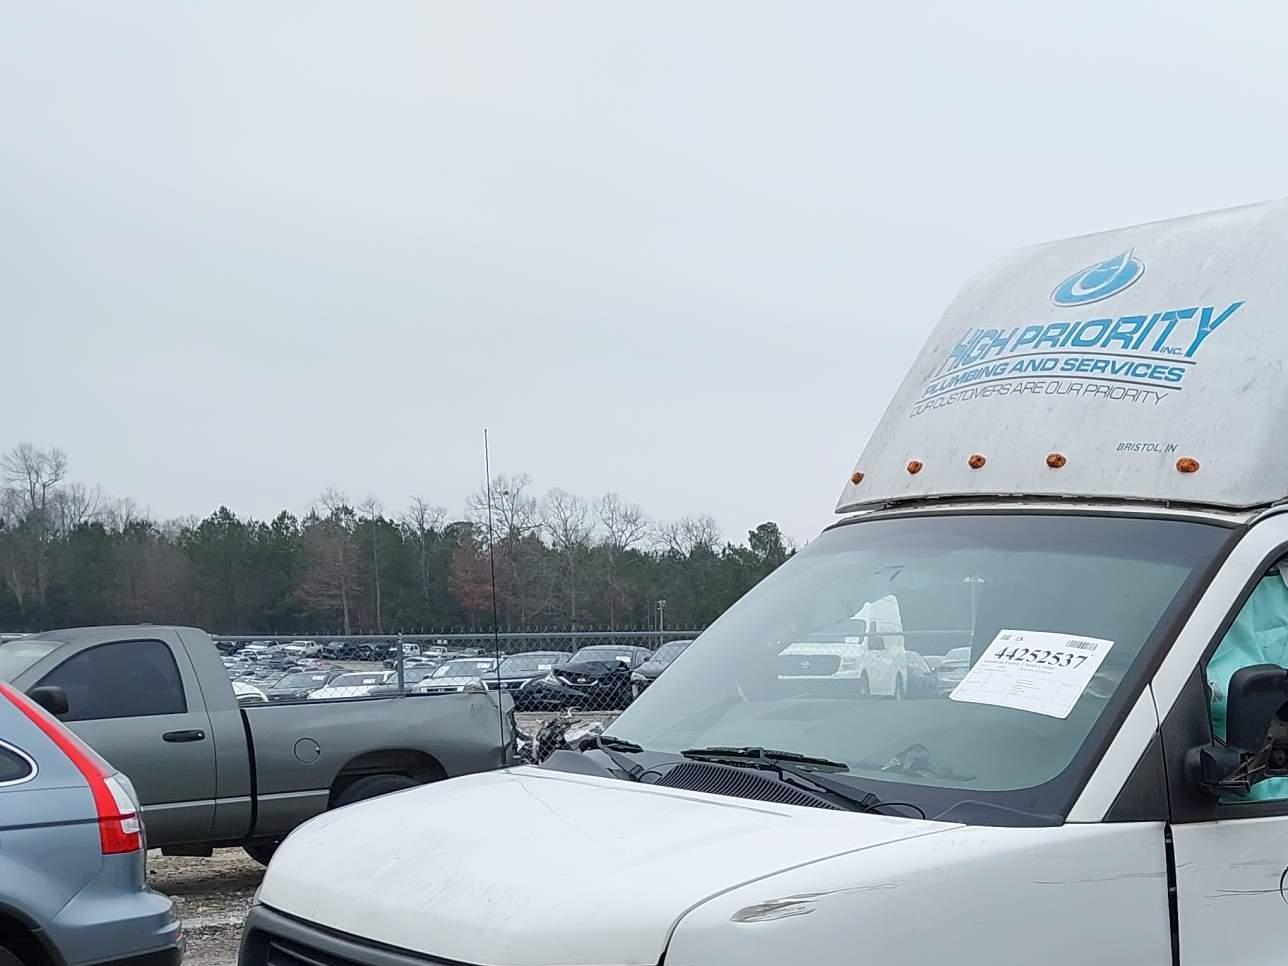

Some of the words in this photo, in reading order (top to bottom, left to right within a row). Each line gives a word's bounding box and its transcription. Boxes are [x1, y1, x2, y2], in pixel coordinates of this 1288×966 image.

[1010, 300, 1247, 358] PRIORITY
[921, 362, 1010, 398] PLUMBING
[1008, 357, 1058, 374] AND
[1060, 358, 1185, 382] SERVICES
[1011, 381, 1046, 394] ARE
[1044, 380, 1083, 397] OUR
[1082, 384, 1168, 405] PRIORITY
[1164, 444, 1178, 452] IN
[994, 646, 1089, 670] 44252537
